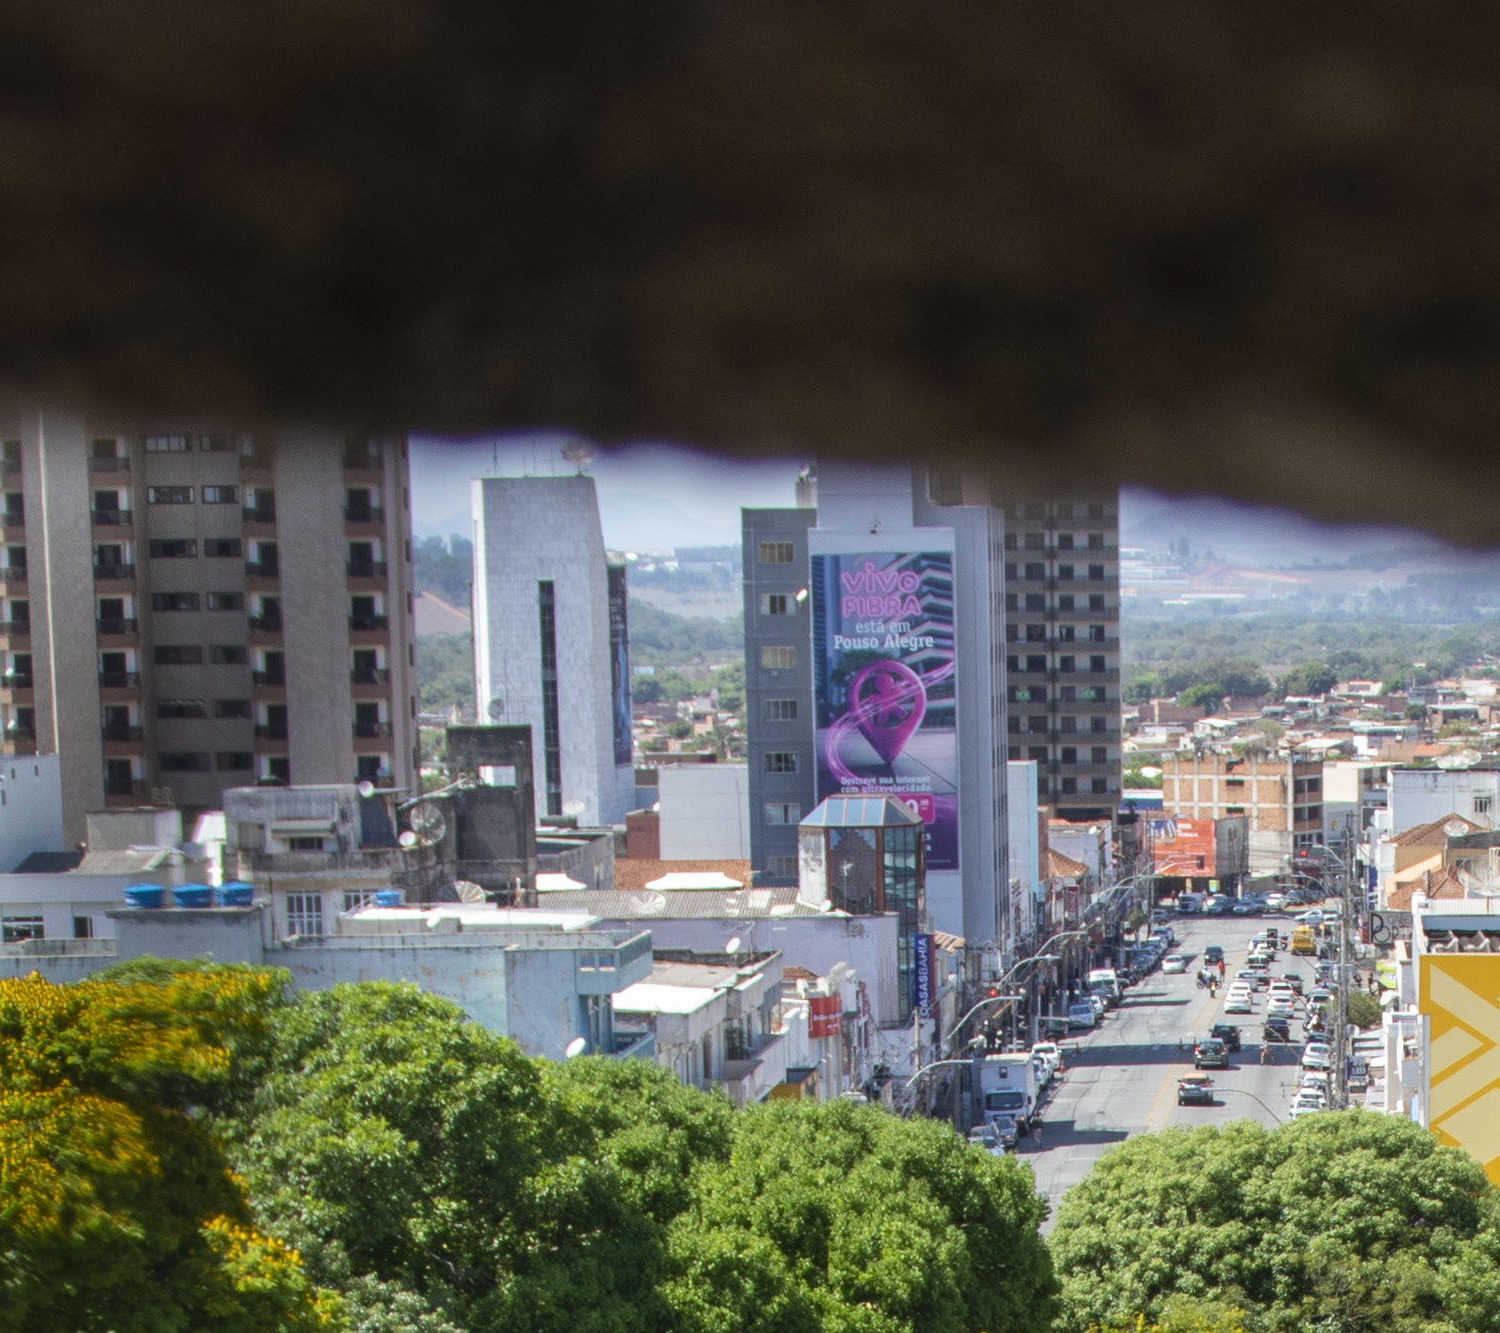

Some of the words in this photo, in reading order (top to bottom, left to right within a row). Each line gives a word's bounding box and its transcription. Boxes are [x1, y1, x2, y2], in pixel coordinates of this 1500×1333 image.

[841, 562, 920, 593] vivo
[842, 595, 922, 618] FIBRA
[855, 618, 885, 633] está
[889, 622, 911, 633] em
[834, 635, 879, 649] Pouso
[884, 634, 934, 651] Alegre
